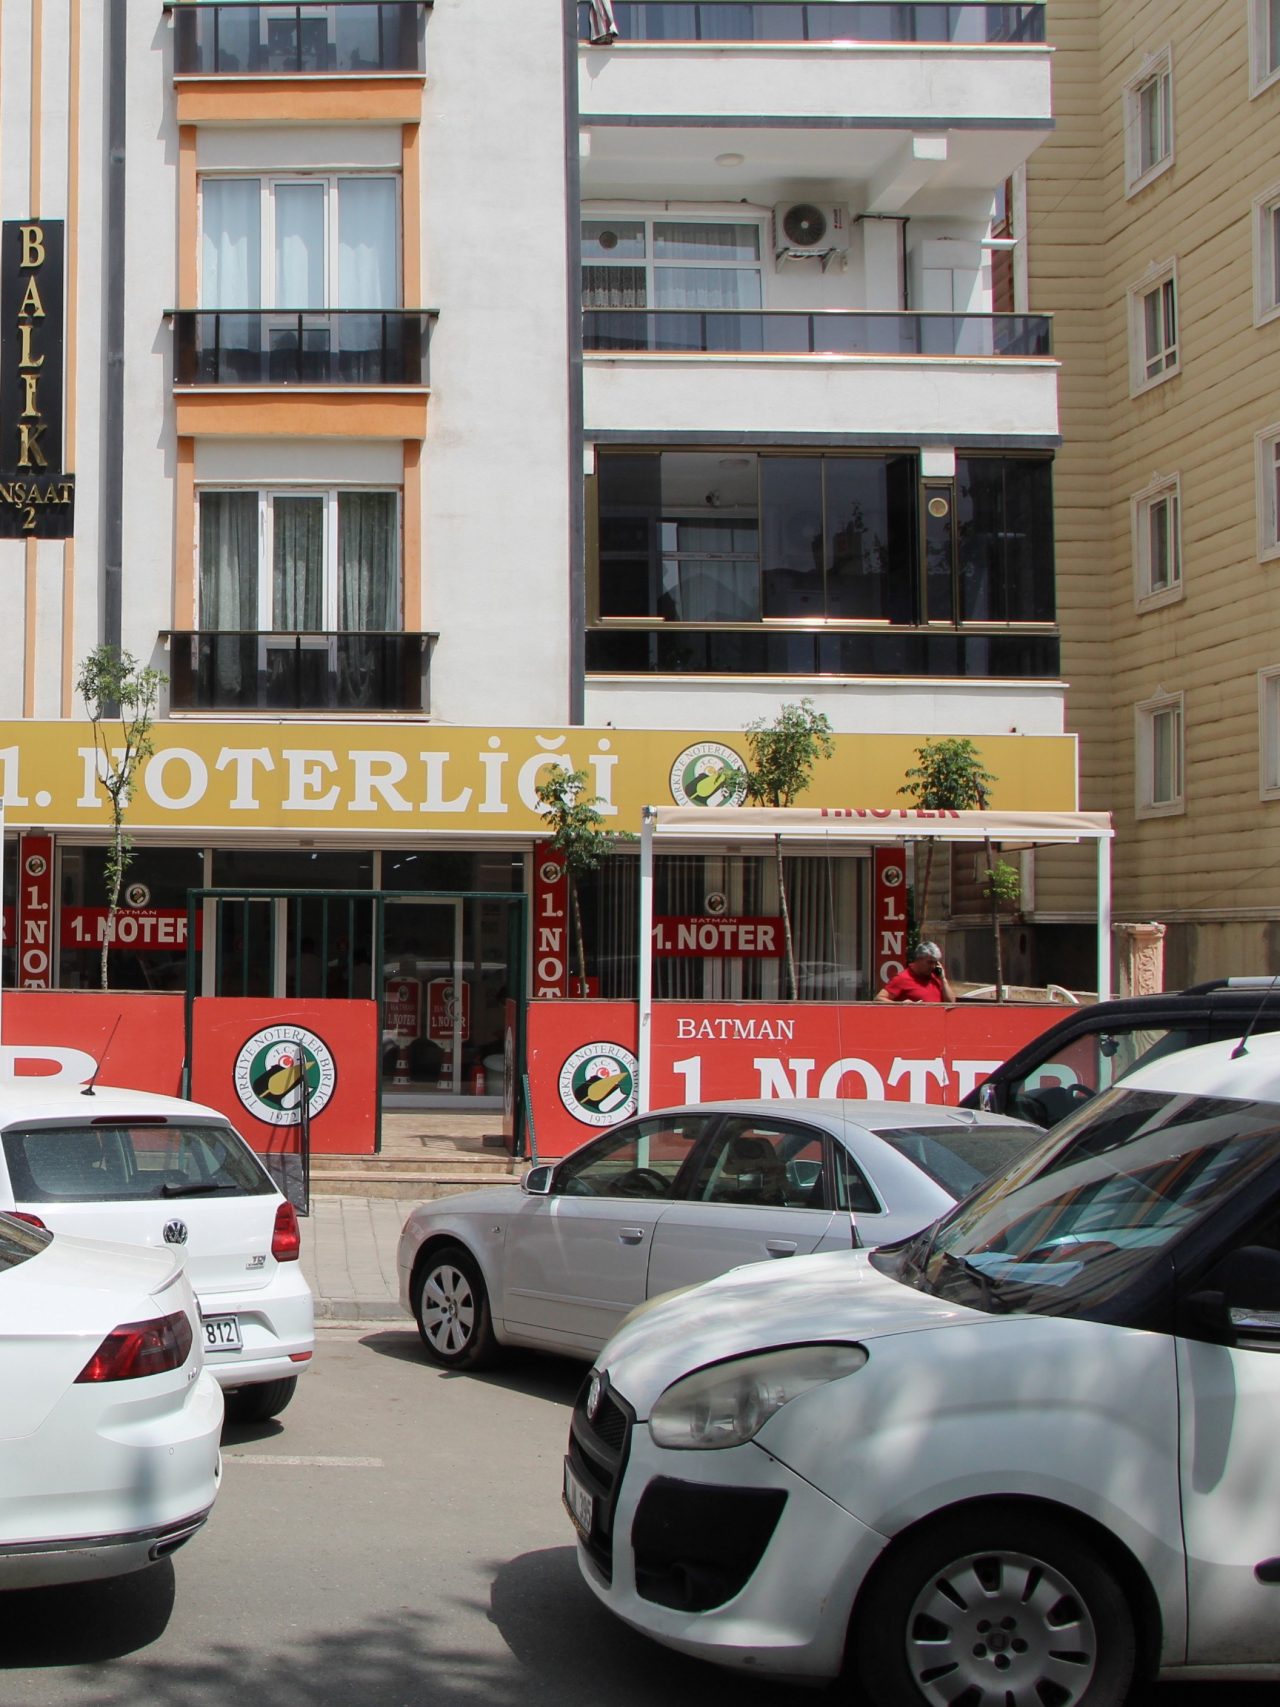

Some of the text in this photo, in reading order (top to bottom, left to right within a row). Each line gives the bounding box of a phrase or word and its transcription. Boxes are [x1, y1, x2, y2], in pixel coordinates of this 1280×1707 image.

[17, 226, 48, 467] BALIK
[22, 507, 37, 529] 2
[76, 735, 618, 816] NOTERLİĞİ
[27, 886, 49, 910] 1.
[541, 893, 564, 917] 1.
[883, 896, 906, 921] 1.
[71, 916, 92, 942] 1.
[651, 923, 776, 951] 1. NOTER
[676, 1018, 796, 1041] BATMAN
[253, 1028, 324, 1056] NOTERLER
[575, 1045, 635, 1067] NOTERLER
[269, 1111, 298, 1122] 1972
[589, 1114, 614, 1125] 1972
[205, 1321, 235, 1345] 812
